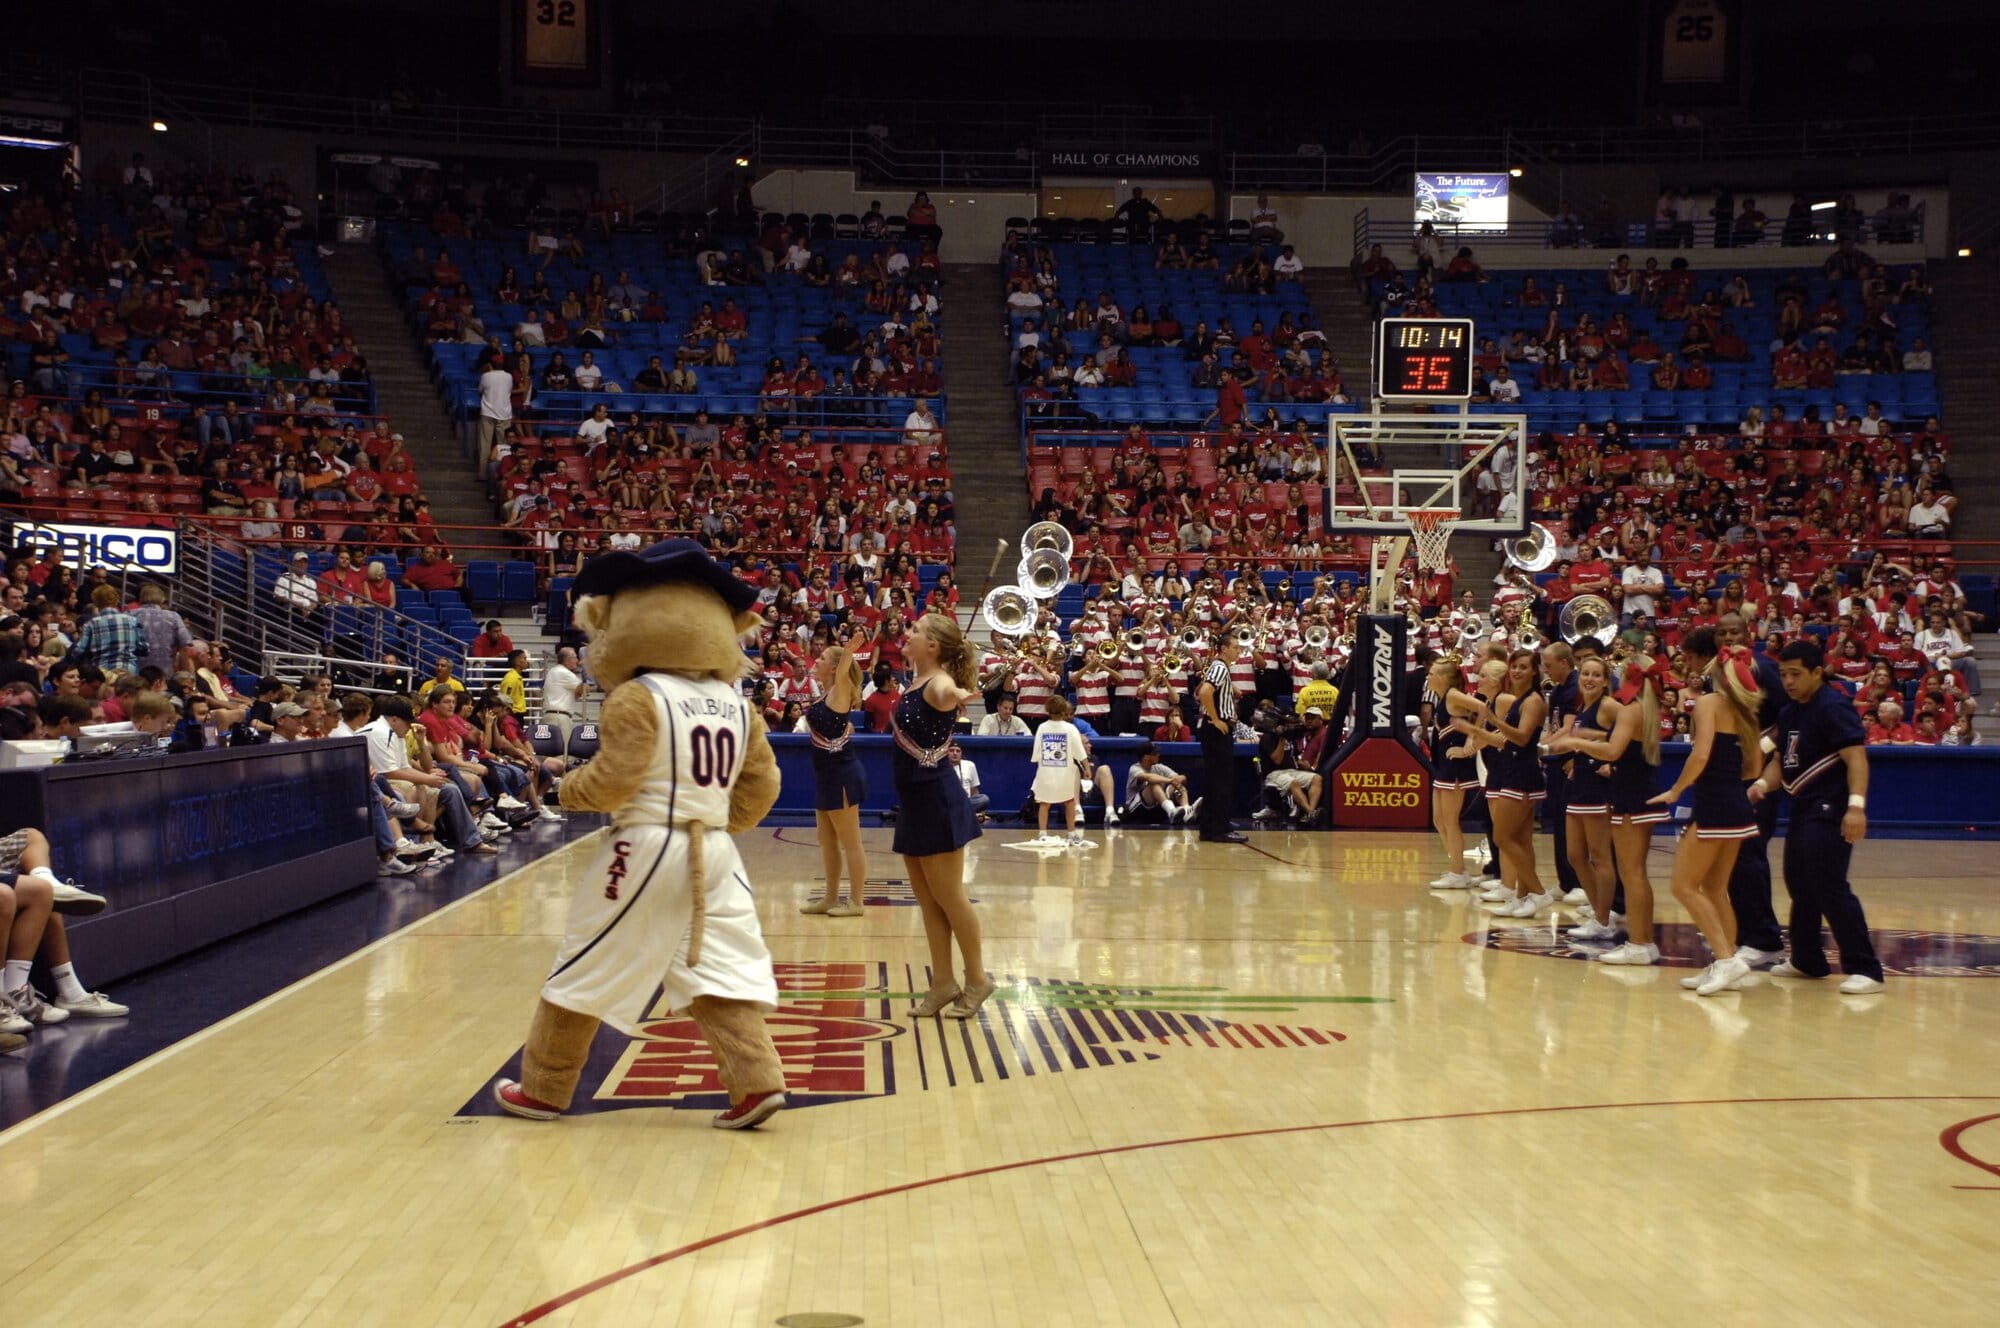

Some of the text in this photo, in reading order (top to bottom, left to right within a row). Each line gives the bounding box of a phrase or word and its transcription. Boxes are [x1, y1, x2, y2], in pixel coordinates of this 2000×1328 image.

[537, 0, 576, 26] 32
[1677, 16, 1713, 41] 25
[1052, 153, 1200, 167] HALL OF CHAMPIONS
[1437, 175, 1488, 186] The Future.
[1400, 327, 1462, 349] 10:14
[1402, 356, 1452, 391] 35
[146, 408, 160, 420] 19
[1192, 437, 1206, 448] 21
[1694, 439, 1710, 451] 22
[292, 525, 305, 538] 19
[18, 530, 172, 567] GEICO
[1372, 624, 1393, 728] ARIZONA
[690, 724, 735, 788] 00
[1341, 773, 1421, 788] WELLS
[1344, 792, 1419, 807] FARGO
[605, 841, 631, 900] CATS
